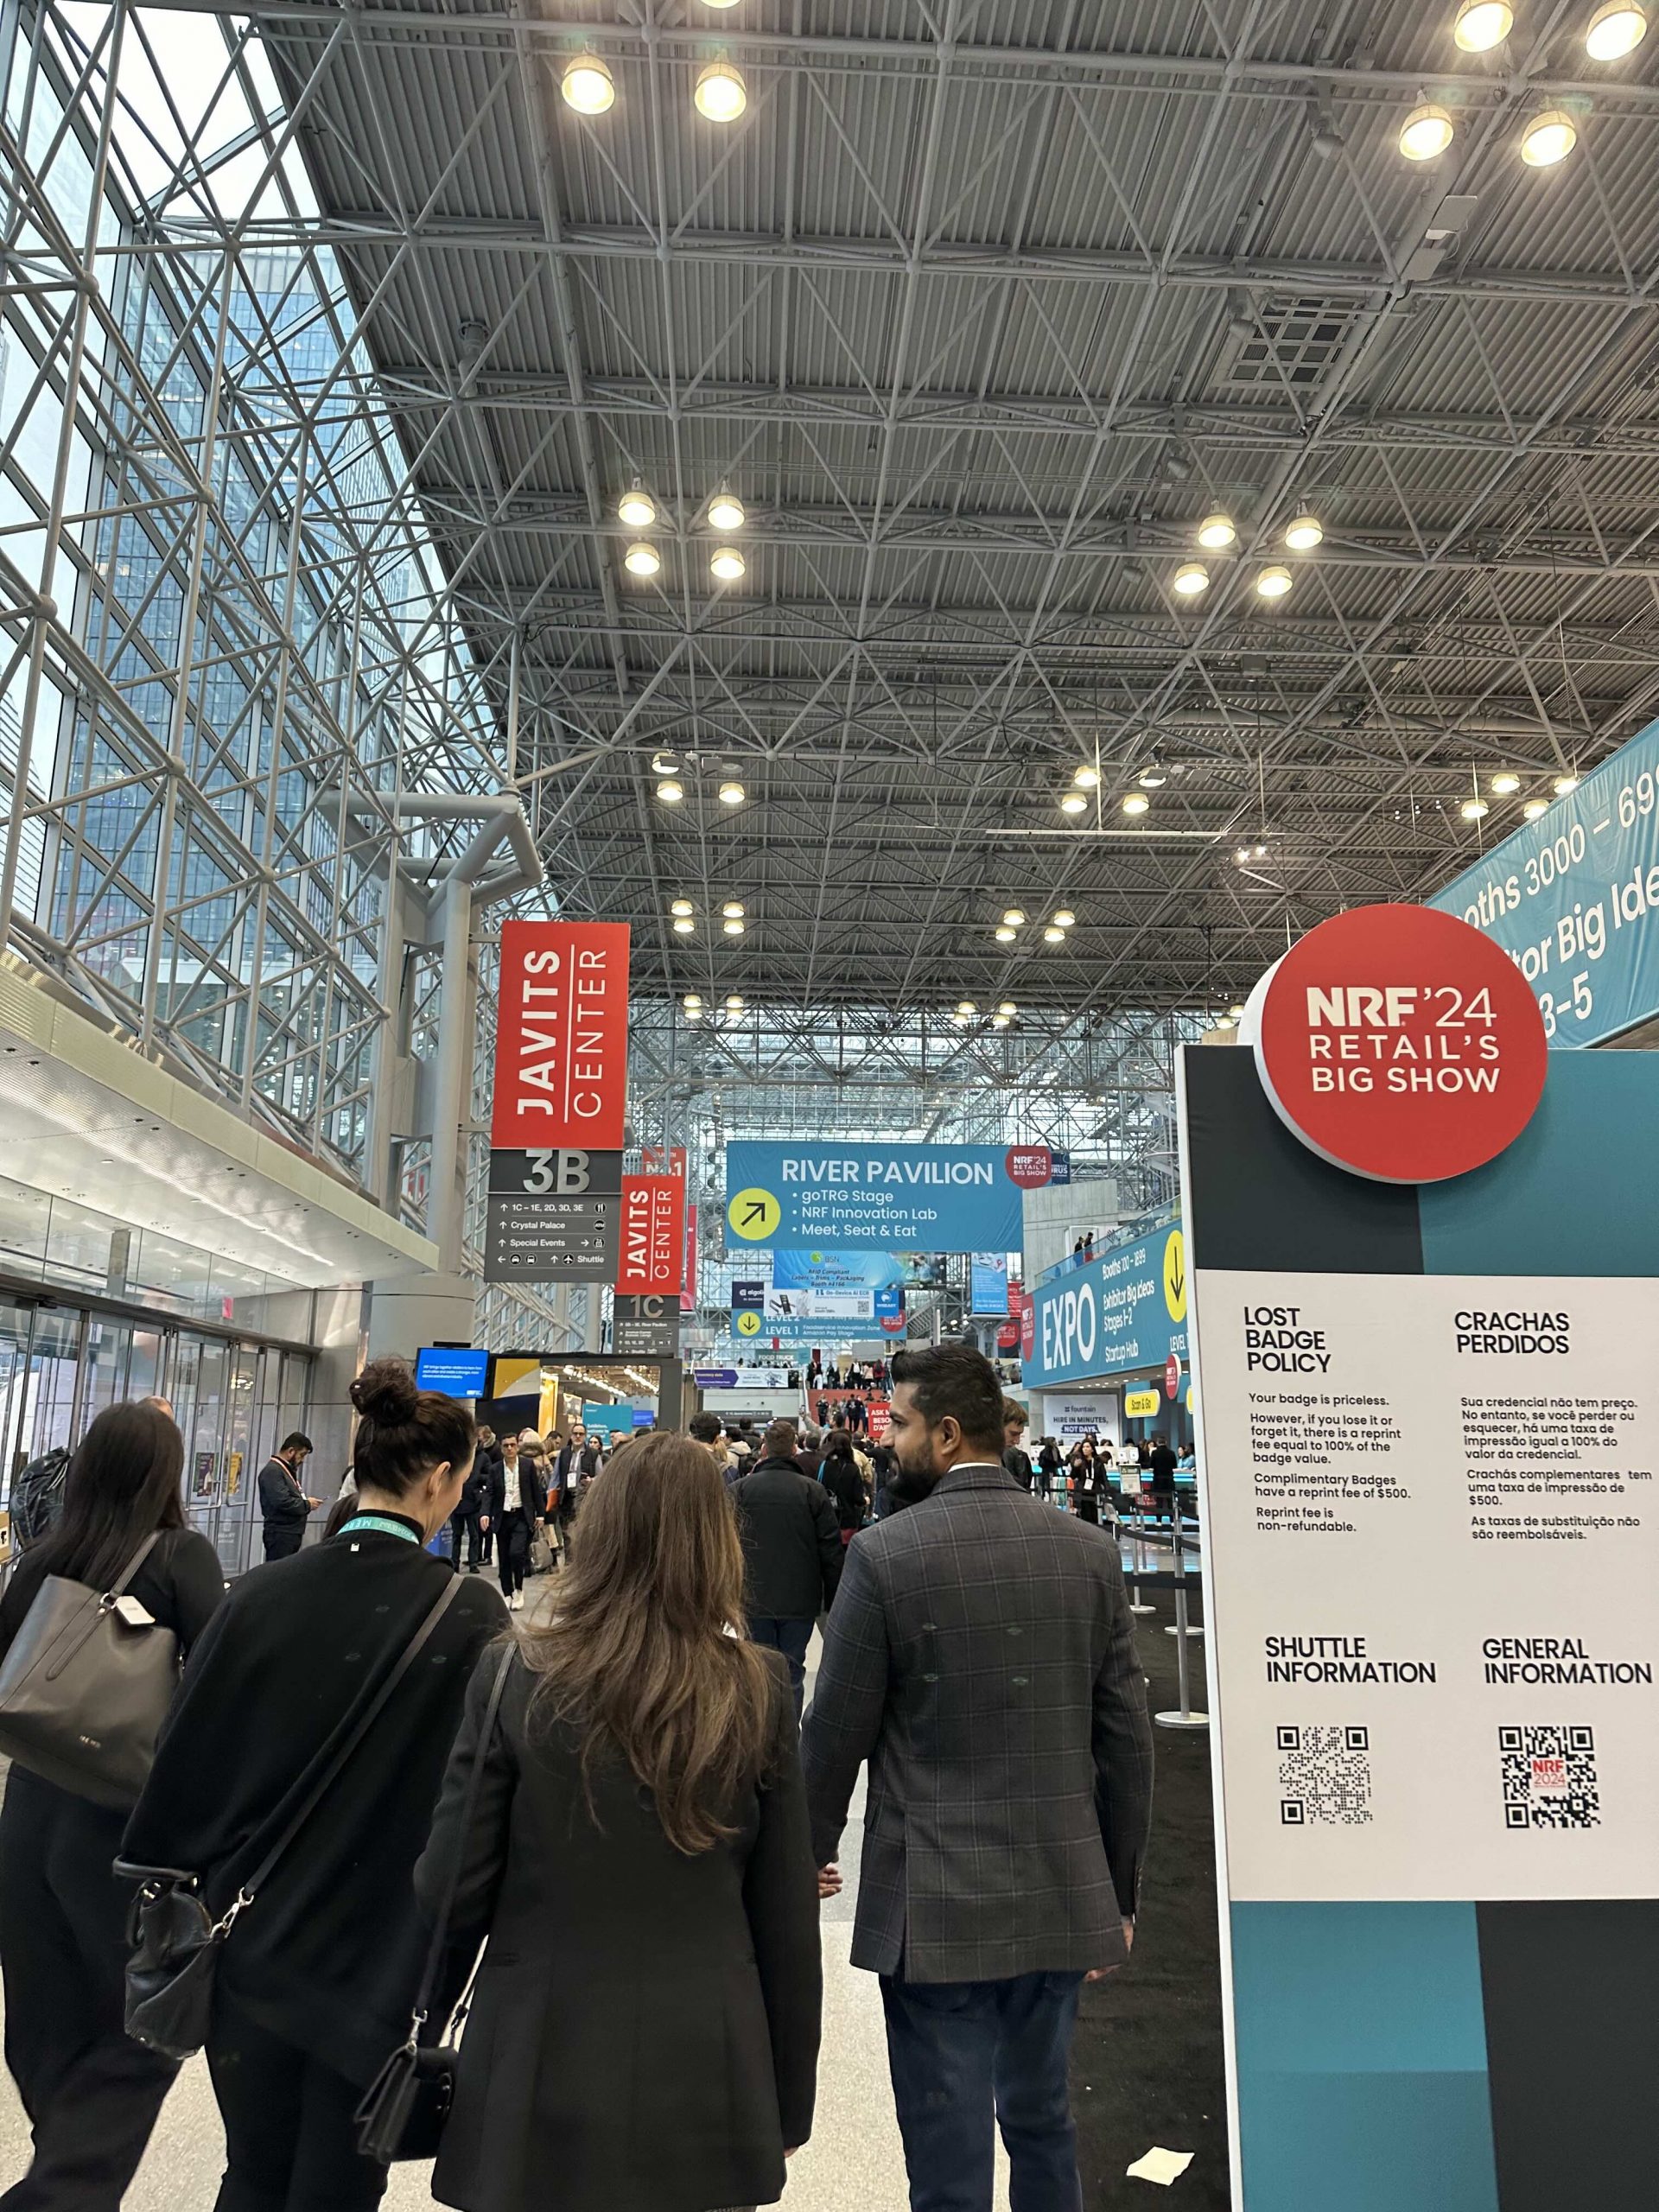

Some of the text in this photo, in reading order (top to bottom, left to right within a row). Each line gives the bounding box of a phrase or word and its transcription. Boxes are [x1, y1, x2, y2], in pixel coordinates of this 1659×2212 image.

[1455, 768, 1659, 931] oths 3000 69
[1504, 935, 1552, 982] tor
[1557, 903, 1606, 960] Big
[518, 950, 560, 1116] JAVITS
[574, 950, 607, 1117] CENTER
[1310, 1034, 1499, 1060] RETAIL'S
[1312, 1067, 1500, 1093] BIG SHOW
[523, 1149, 591, 1194] 3B
[783, 1160, 994, 1185] RIVER PAVILION
[802, 1190, 893, 1206] goTRG Stage
[802, 1206, 938, 1220] NRF Innovation Lab
[511, 1221, 565, 1230] Crystal Palace
[802, 1224, 917, 1237] Meet, Seat & Eat
[627, 1190, 649, 1278] JAVITS
[654, 1190, 672, 1279] CENTER
[510, 1238, 537, 1249] Special
[1102, 1257, 1122, 1281] Booths
[1103, 1287, 1126, 1311] Exhibitor
[1127, 1282, 1137, 1306] Big
[630, 1294, 664, 1319] 1C
[1243, 1306, 1300, 1326] LOST
[1455, 1312, 1569, 1332] CRACHAS
[766, 1325, 798, 1335] LEVEL 1
[1042, 1282, 1096, 1370] EXPO
[1103, 1313, 1123, 1336] Stages
[1169, 1334, 1186, 1352] LEVEL
[1246, 1330, 1325, 1351] BADGE
[1457, 1335, 1569, 1354] PERDIDOS
[1105, 1338, 1139, 1366] Startup Hub
[1247, 1351, 1331, 1373] POLICY
[1131, 1399, 1141, 1410] Scan
[1248, 1393, 1389, 1408] Your badge is priceless.
[1460, 1397, 1637, 1410] Sua credencial não tem preço.
[1249, 1413, 1392, 1427] However, if you lose it or
[1461, 1410, 1478, 1420] No
[1480, 1411, 1529, 1421] entanto,
[1547, 1410, 1575, 1420] você
[1578, 1410, 1617, 1423] perder
[1619, 1413, 1634, 1421] ou
[1250, 1426, 1287, 1440] forget
[1289, 1426, 1300, 1439] it,
[1303, 1427, 1335, 1438] there
[1338, 1427, 1347, 1438] is
[1361, 1428, 1401, 1441] reprint
[1463, 1423, 1614, 1436] esquecer, há uma taxa de
[1251, 1439, 1390, 1453] fee equal to 100% of the
[1464, 1435, 1618, 1449] impressão igual a 100% do
[1253, 1452, 1331, 1465] badge value.
[1465, 1448, 1581, 1459] valor da credencial.
[1254, 1472, 1396, 1488] Complimentary Badges
[1466, 1468, 1652, 1482] Crachás complementares tem
[1255, 1484, 1286, 1497] have
[1299, 1487, 1339, 1501] reprint
[1341, 1485, 1360, 1497] fee
[1363, 1488, 1374, 1498] of
[1376, 1486, 1410, 1499] $500.
[1467, 1482, 1624, 1496] uma taxa de impressão de
[1469, 1495, 1502, 1506] $500.
[1255, 1507, 1333, 1520] Reprint fee is
[1257, 1519, 1356, 1532] non-refundable.
[1471, 1516, 1640, 1529] As taxas de substituição não
[1471, 1529, 1586, 1540] são reembolsáveis.
[1265, 1637, 1366, 1658] SHUTTLE
[1482, 1638, 1589, 1659] GENERAL
[1267, 1662, 1436, 1683] INFORMATION
[1484, 1662, 1652, 1684] INFORMATION
[1532, 1759, 1563, 1773] NRF
[1534, 1773, 1566, 1785] 2024
